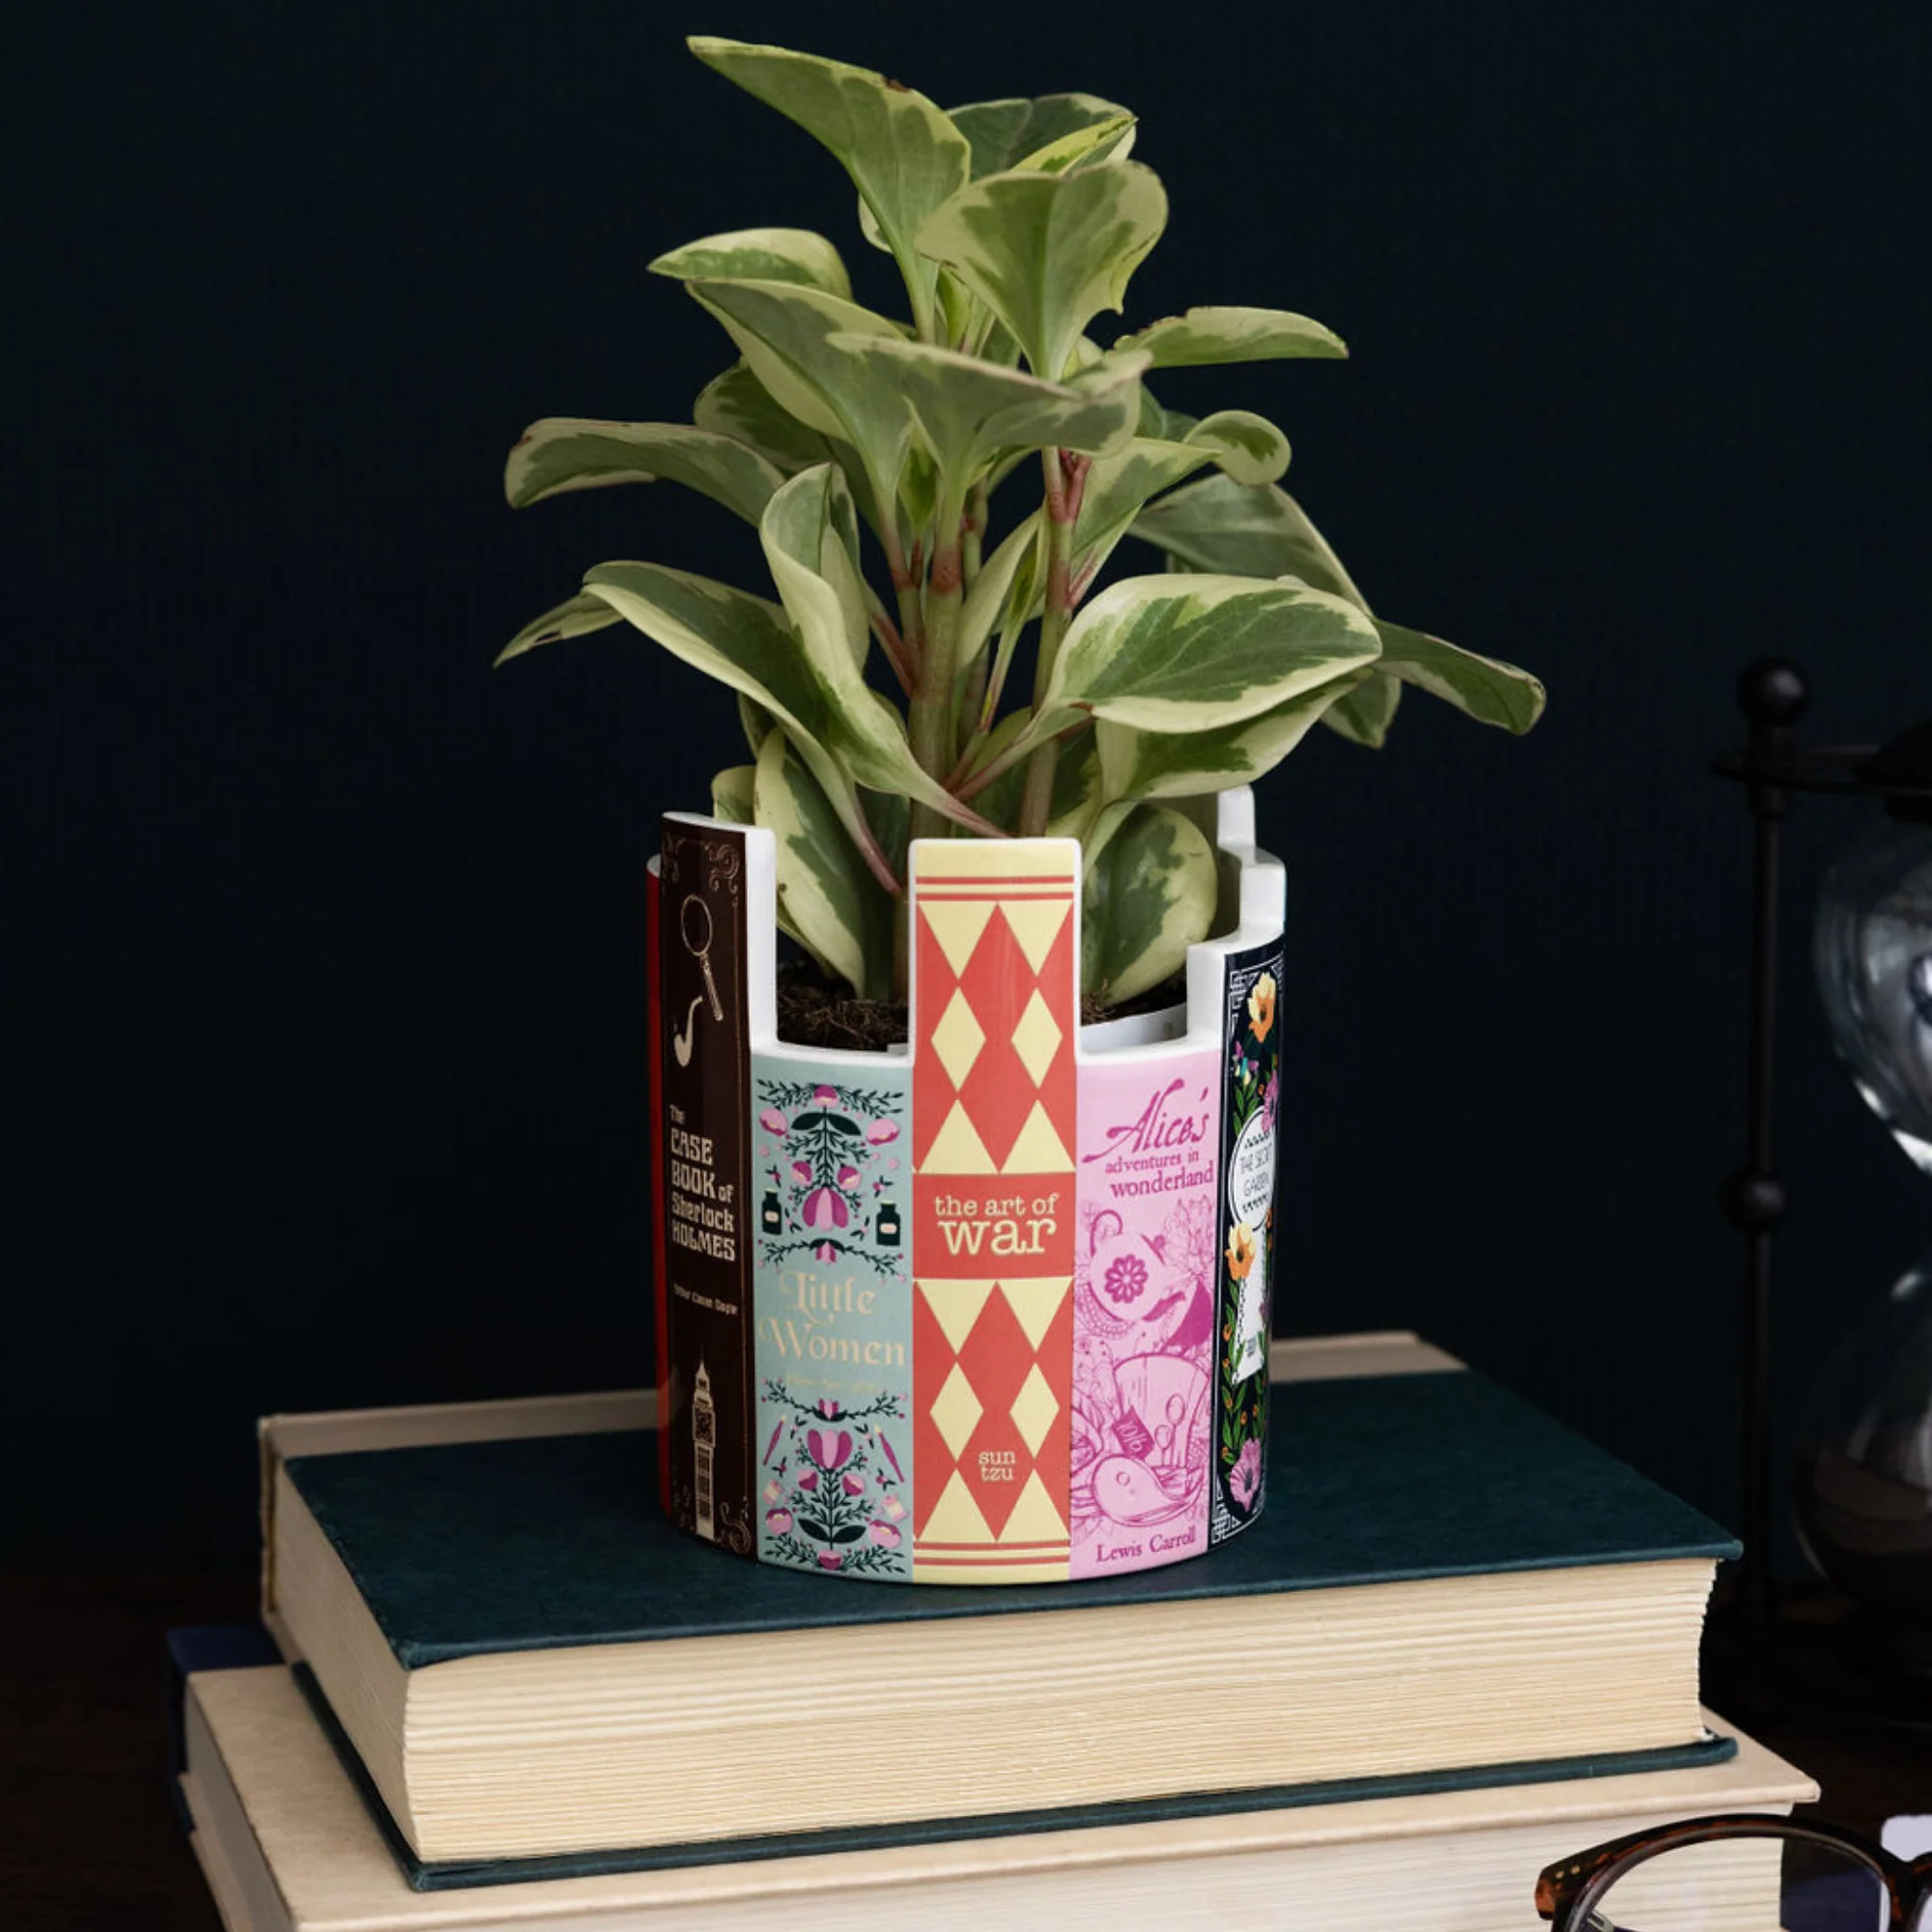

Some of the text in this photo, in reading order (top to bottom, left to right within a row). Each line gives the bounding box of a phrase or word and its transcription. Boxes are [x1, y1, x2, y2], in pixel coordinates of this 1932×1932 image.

[670, 1127, 713, 1165] CASE
[1105, 1148, 1199, 1174] adventures in
[670, 1159, 734, 1203] BOOK of
[1109, 1160, 1214, 1198] wonderland
[670, 1192, 735, 1233] Sherlock
[934, 1193, 1059, 1216] the art of
[671, 1219, 735, 1262] HOLMES
[937, 1218, 1057, 1256] war
[779, 1270, 875, 1325] Little
[757, 1317, 905, 1366] Women
[979, 1451, 1015, 1464] sun
[980, 1464, 1012, 1481] tzu
[1096, 1525, 1196, 1562] Lewis Carroll
